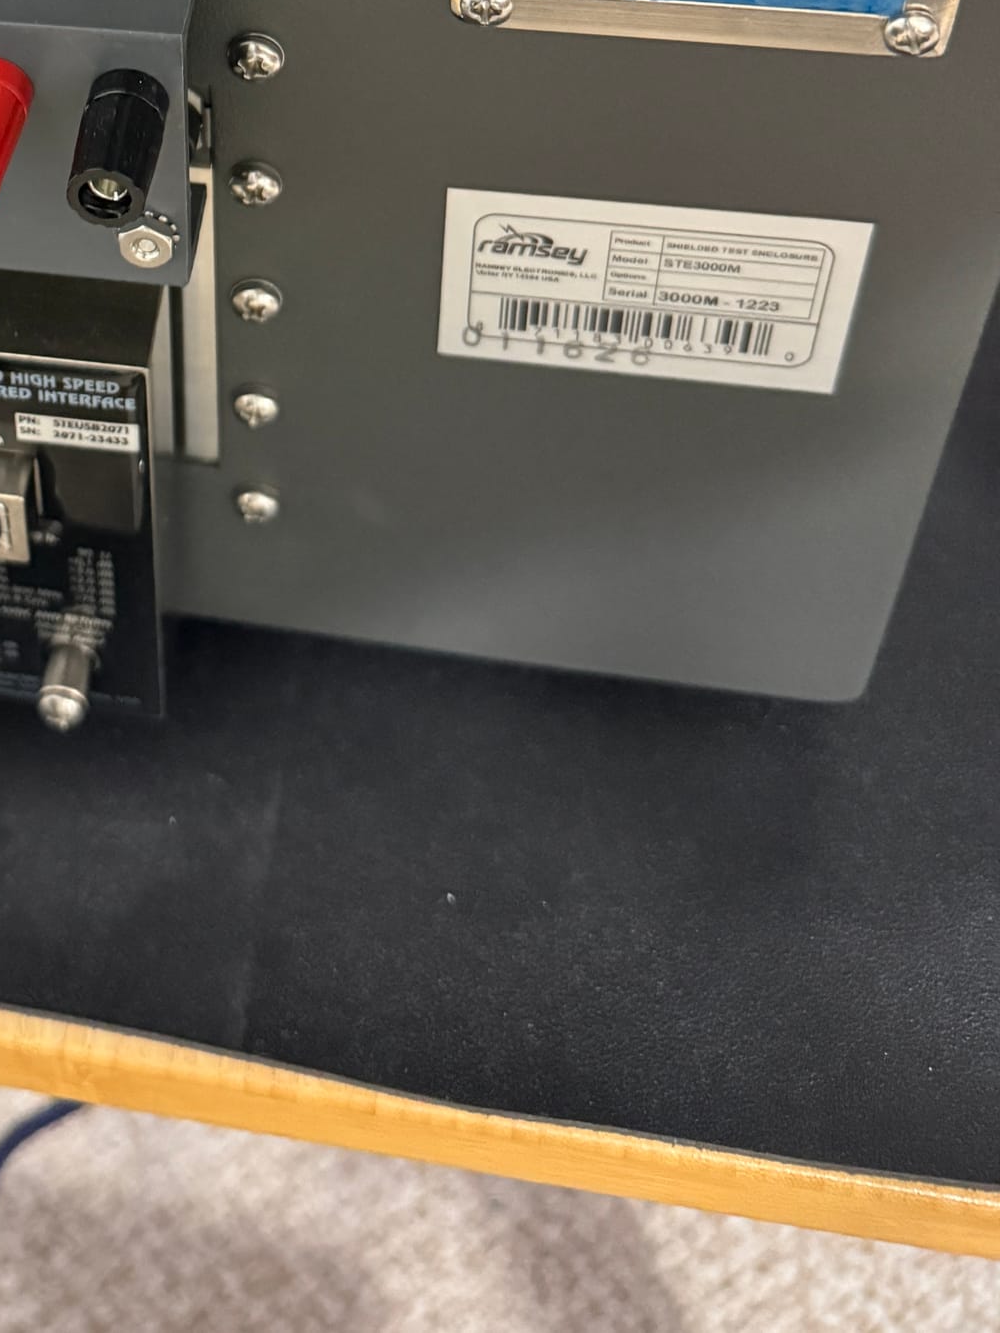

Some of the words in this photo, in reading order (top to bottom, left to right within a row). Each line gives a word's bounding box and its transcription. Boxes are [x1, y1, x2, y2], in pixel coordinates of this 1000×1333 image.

[477, 238, 589, 266] ramsey
[614, 237, 651, 247] Product
[666, 242, 719, 253] SHIELDED
[722, 245, 749, 255] TEST
[751, 249, 819, 262] ENCLOSURE
[611, 254, 648, 265] Model
[663, 257, 741, 274] STE3000M
[607, 287, 648, 299] Serial
[657, 289, 720, 306] 3000M
[735, 298, 781, 312] 1223
[10, 371, 57, 389] HIGH
[62, 376, 120, 395] SPEED
[38, 389, 137, 411] INTERFACE
